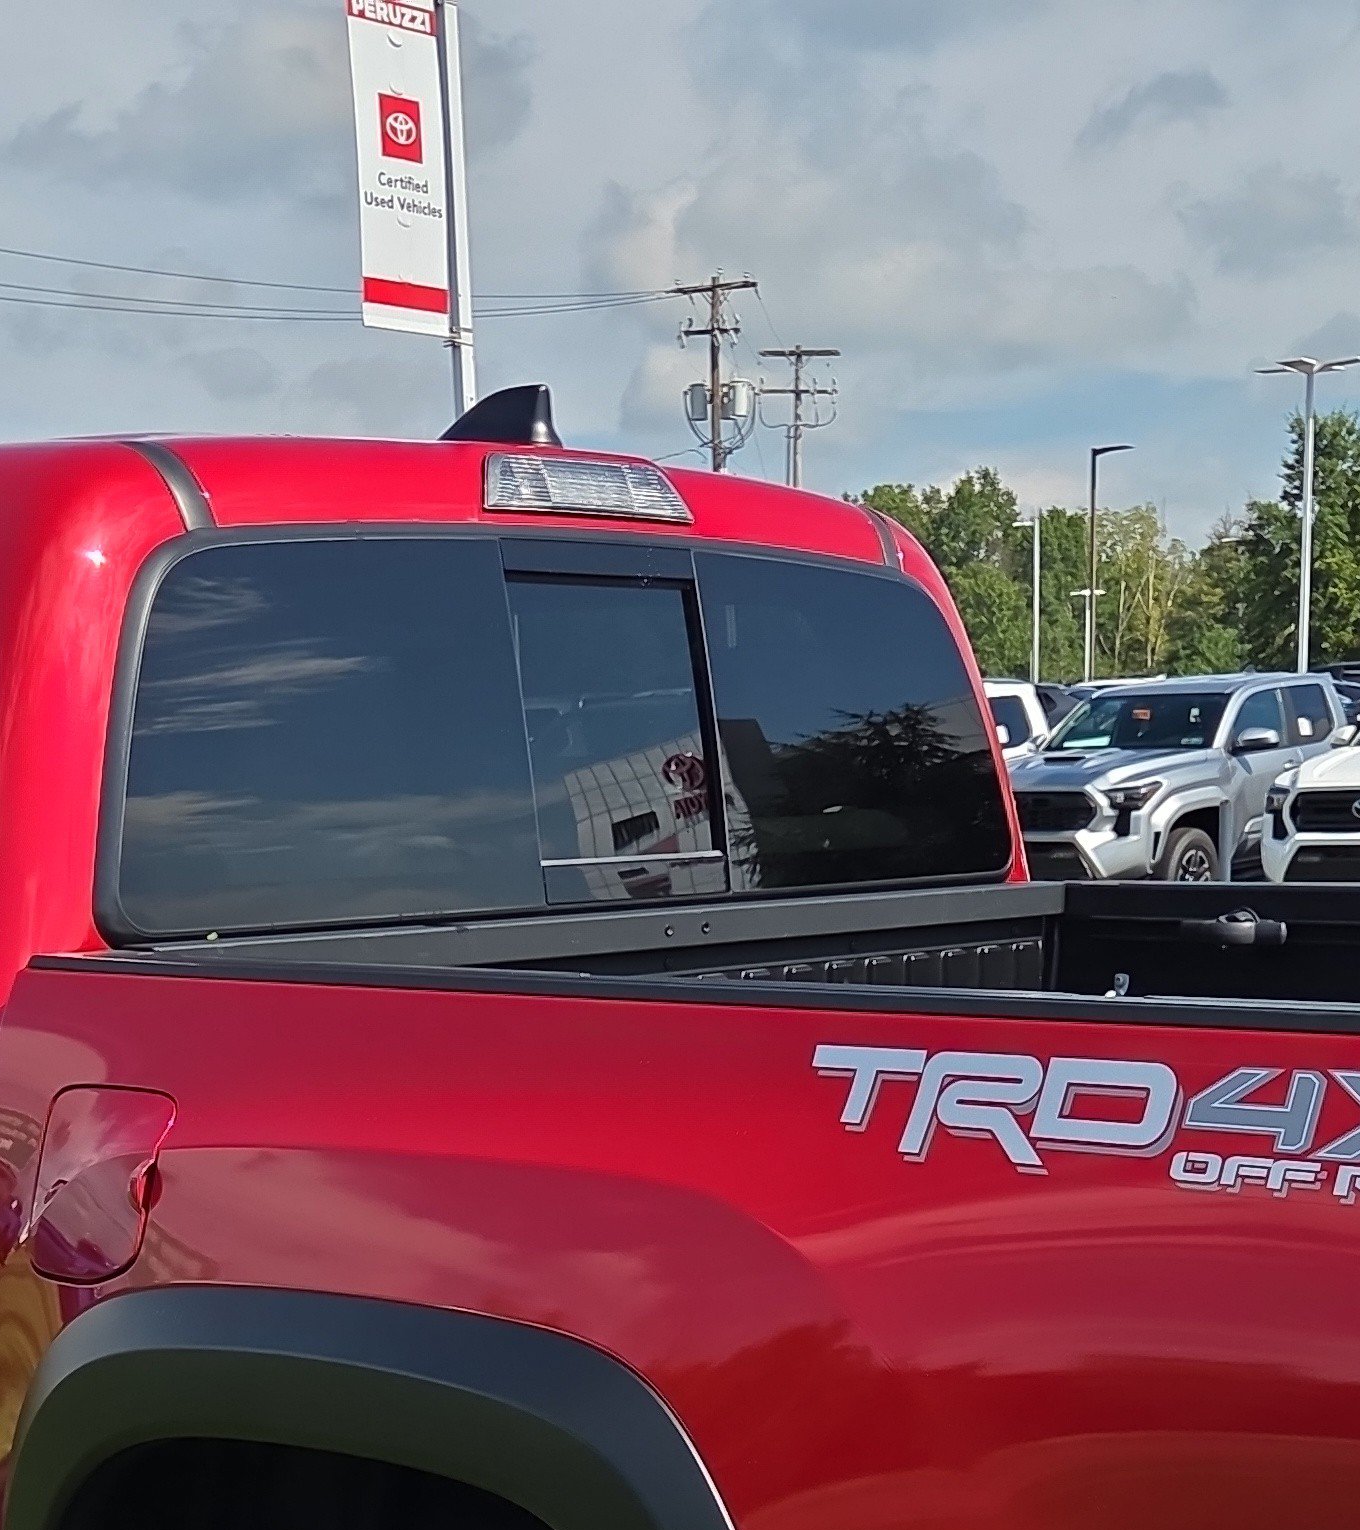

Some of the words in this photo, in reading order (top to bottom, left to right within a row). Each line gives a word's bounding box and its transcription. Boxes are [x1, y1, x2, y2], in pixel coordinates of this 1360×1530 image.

[352, 0, 431, 33] PERUZZI
[378, 172, 428, 194] Certified
[364, 191, 394, 210] Used
[397, 196, 443, 218] Vehicles
[812, 1044, 1183, 1175] TRD
[1169, 1151, 1328, 1198] OFF
